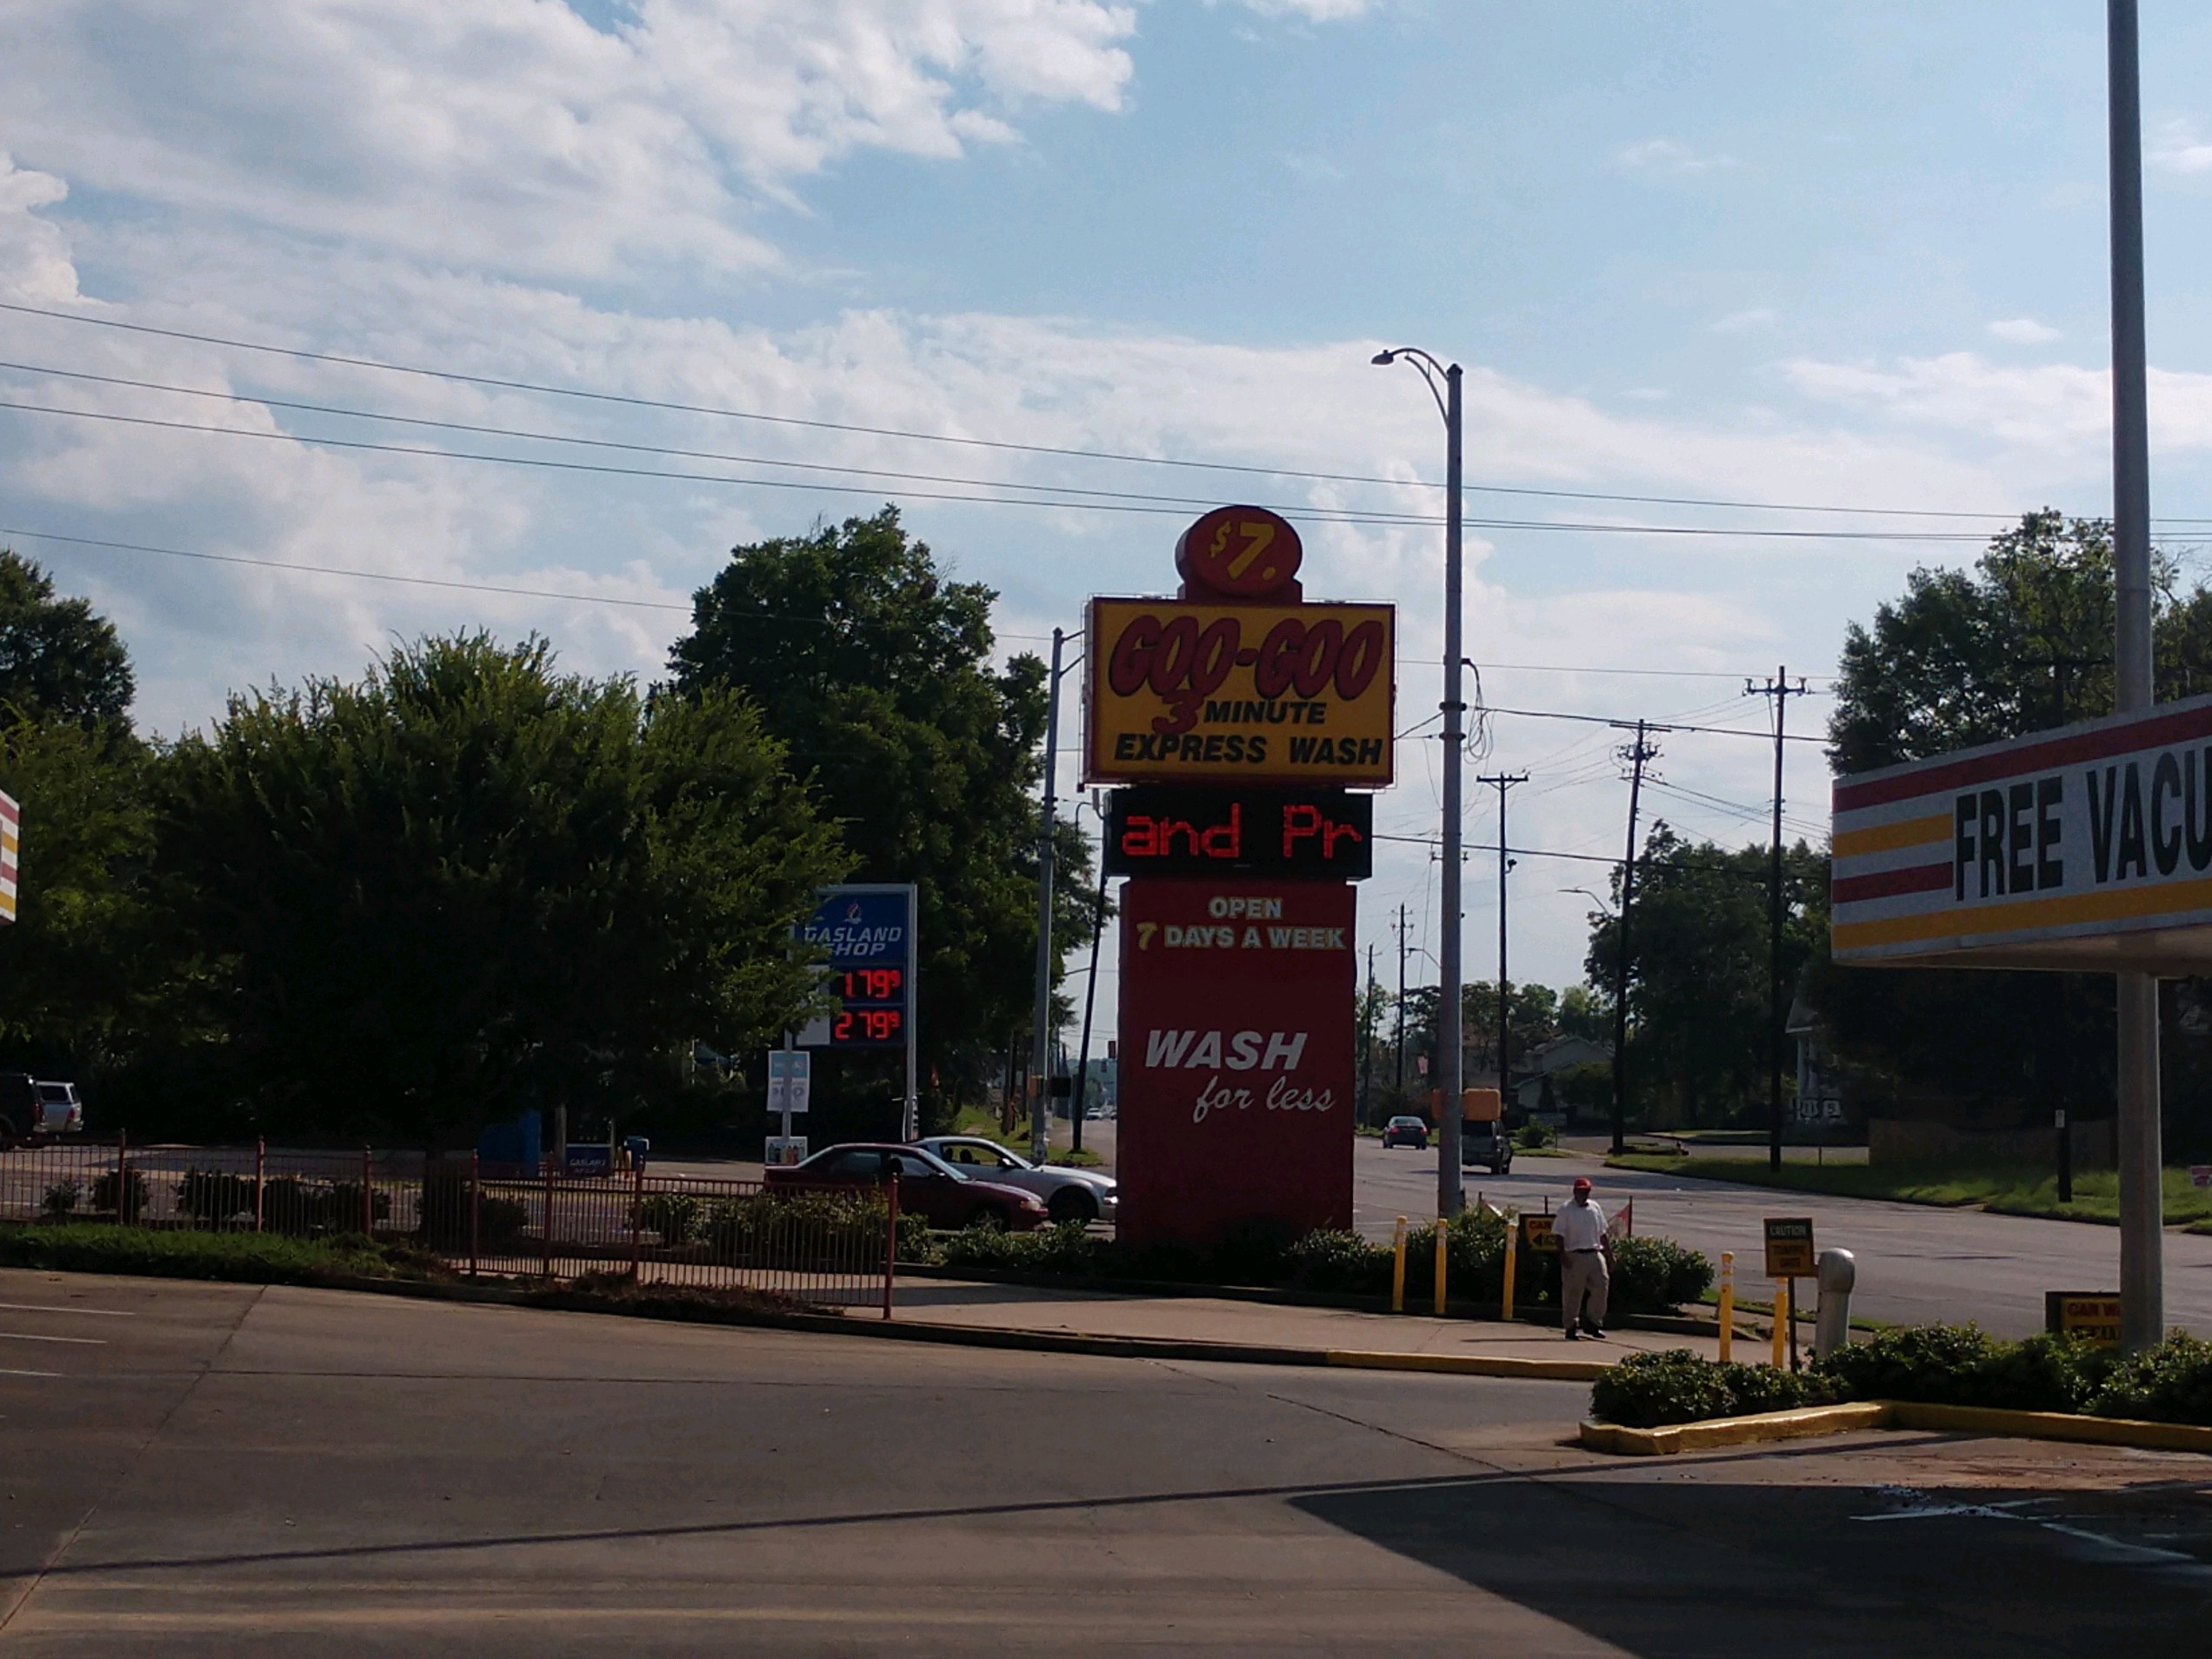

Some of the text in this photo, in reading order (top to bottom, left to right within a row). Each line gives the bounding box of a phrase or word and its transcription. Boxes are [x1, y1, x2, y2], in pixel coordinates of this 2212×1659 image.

[1109, 615, 1385, 701] GOO-GOO
[1151, 690, 1327, 734] 3 MINUTE
[1114, 733, 1383, 765] EXPRESS WASH
[1122, 803, 1363, 859] and Pr
[1955, 775, 2063, 902] FREE
[1209, 896, 1283, 920] OPEN
[803, 926, 903, 943] GASLAND
[1136, 922, 1348, 951] 7 DAYS A WEEK
[1144, 1029, 1308, 1071] WASH
[1192, 1075, 1336, 1124] for less
[1769, 1223, 1807, 1236] CAUTION
